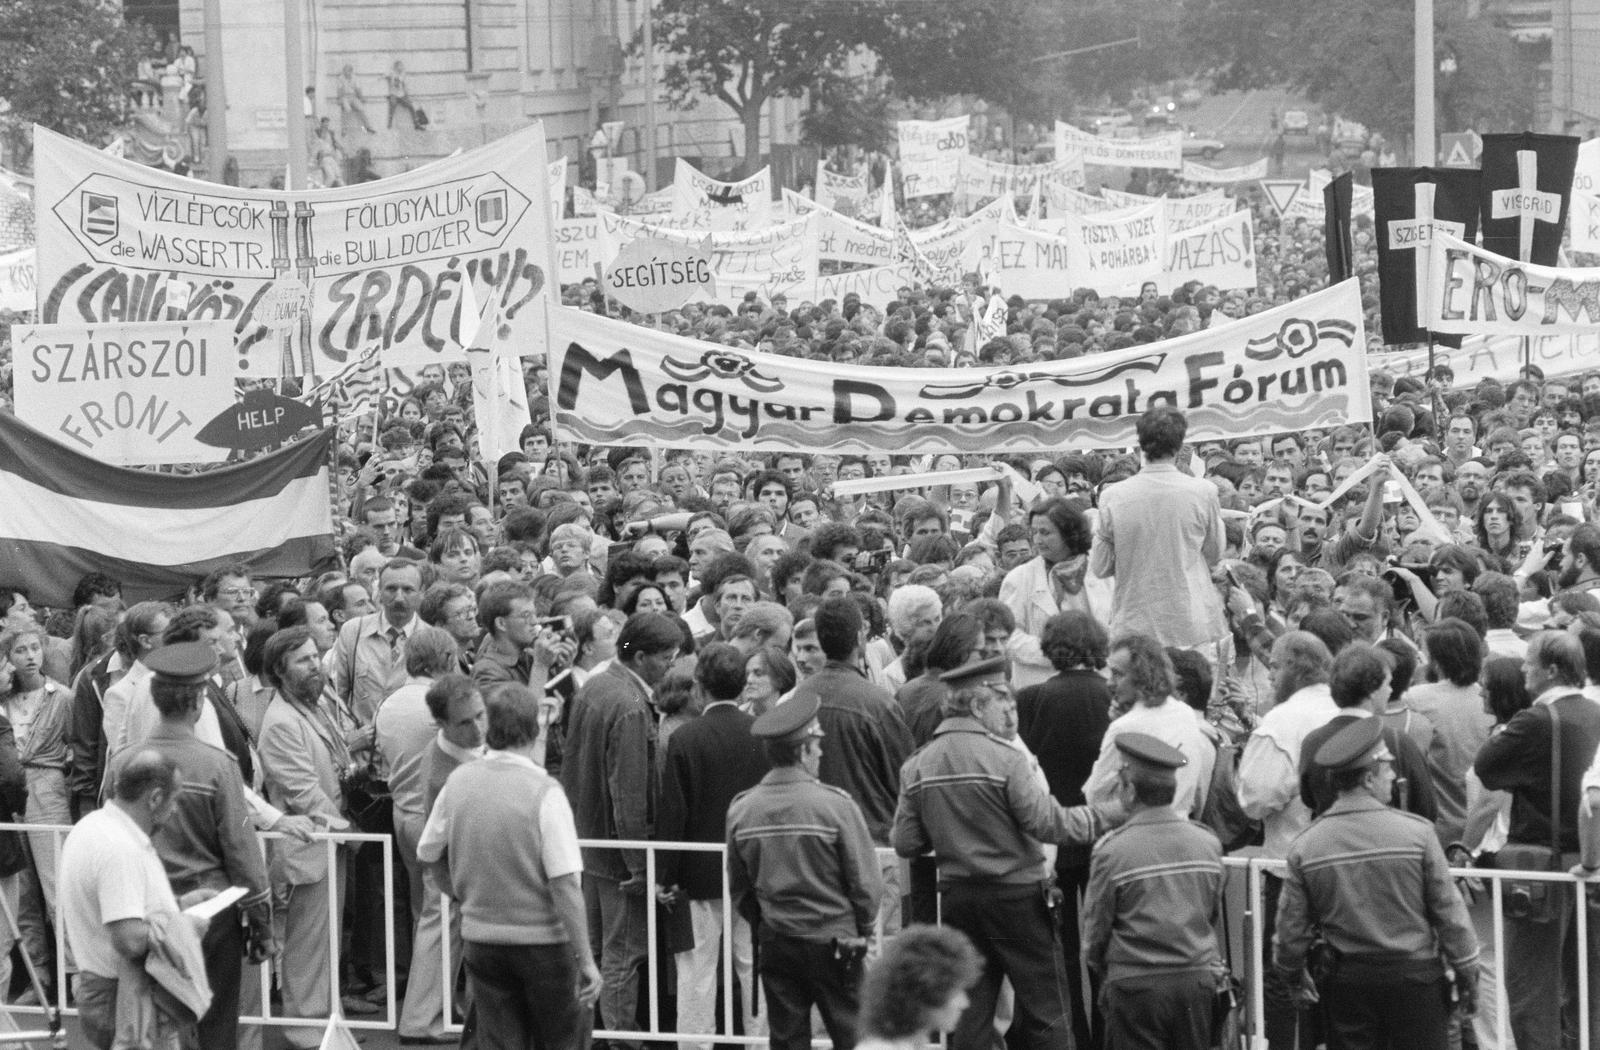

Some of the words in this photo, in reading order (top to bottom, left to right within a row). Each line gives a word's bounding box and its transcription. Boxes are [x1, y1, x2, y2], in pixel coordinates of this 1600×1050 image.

[346, 185, 473, 231] FÖLDGYALUK
[111, 241, 136, 258] die
[138, 230, 269, 269] WASSERTR.
[319, 251, 342, 266] die
[345, 220, 471, 265] BULLDOZER
[1000, 240, 1026, 269] EZ
[1081, 224, 1119, 245] TISZTA
[612, 256, 710, 288] SEGÍTSÉG
[31, 326, 207, 382] SZÁRSZÓI
[556, 341, 827, 439] Magyar
[832, 377, 1178, 425] Demokrata
[1184, 351, 1348, 409] Fórum
[59, 391, 193, 449] FRONT
[237, 407, 286, 431] HELP
